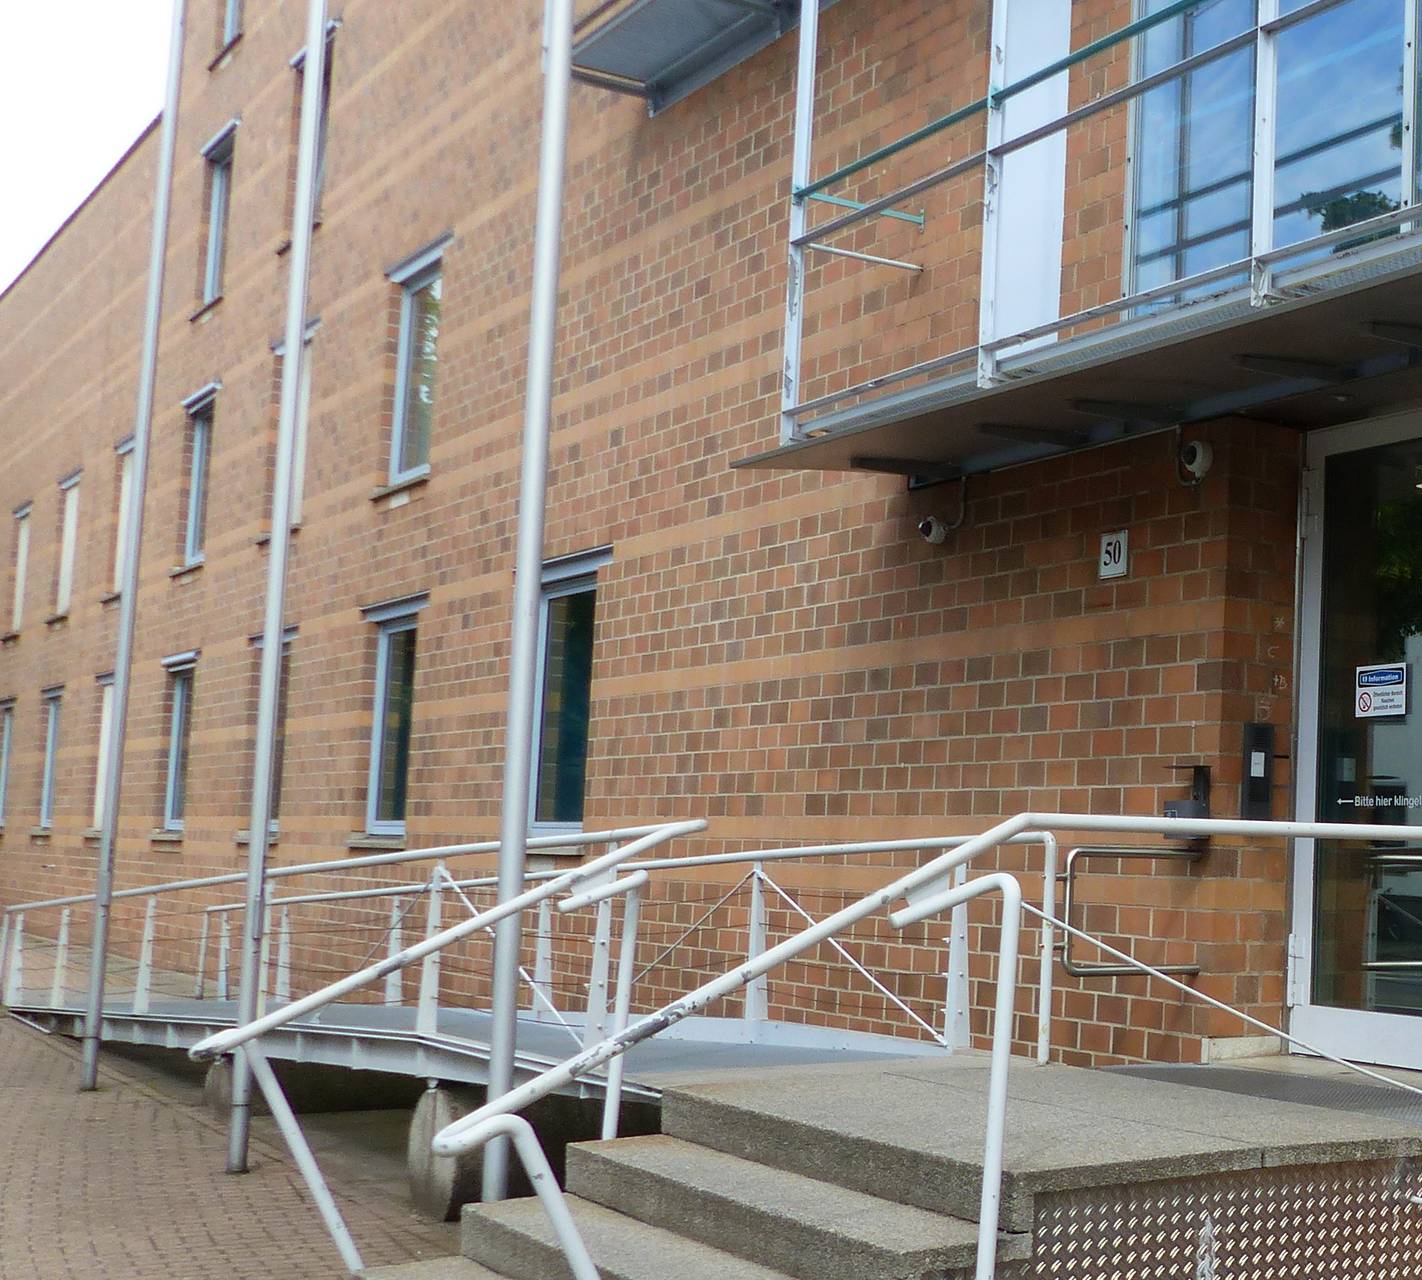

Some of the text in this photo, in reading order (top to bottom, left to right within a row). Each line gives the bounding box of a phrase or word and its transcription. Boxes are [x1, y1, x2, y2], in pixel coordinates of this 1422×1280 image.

[1103, 540, 1121, 566] 50
[1354, 795, 1374, 807] Bitte
[1375, 795, 1393, 807] hier
